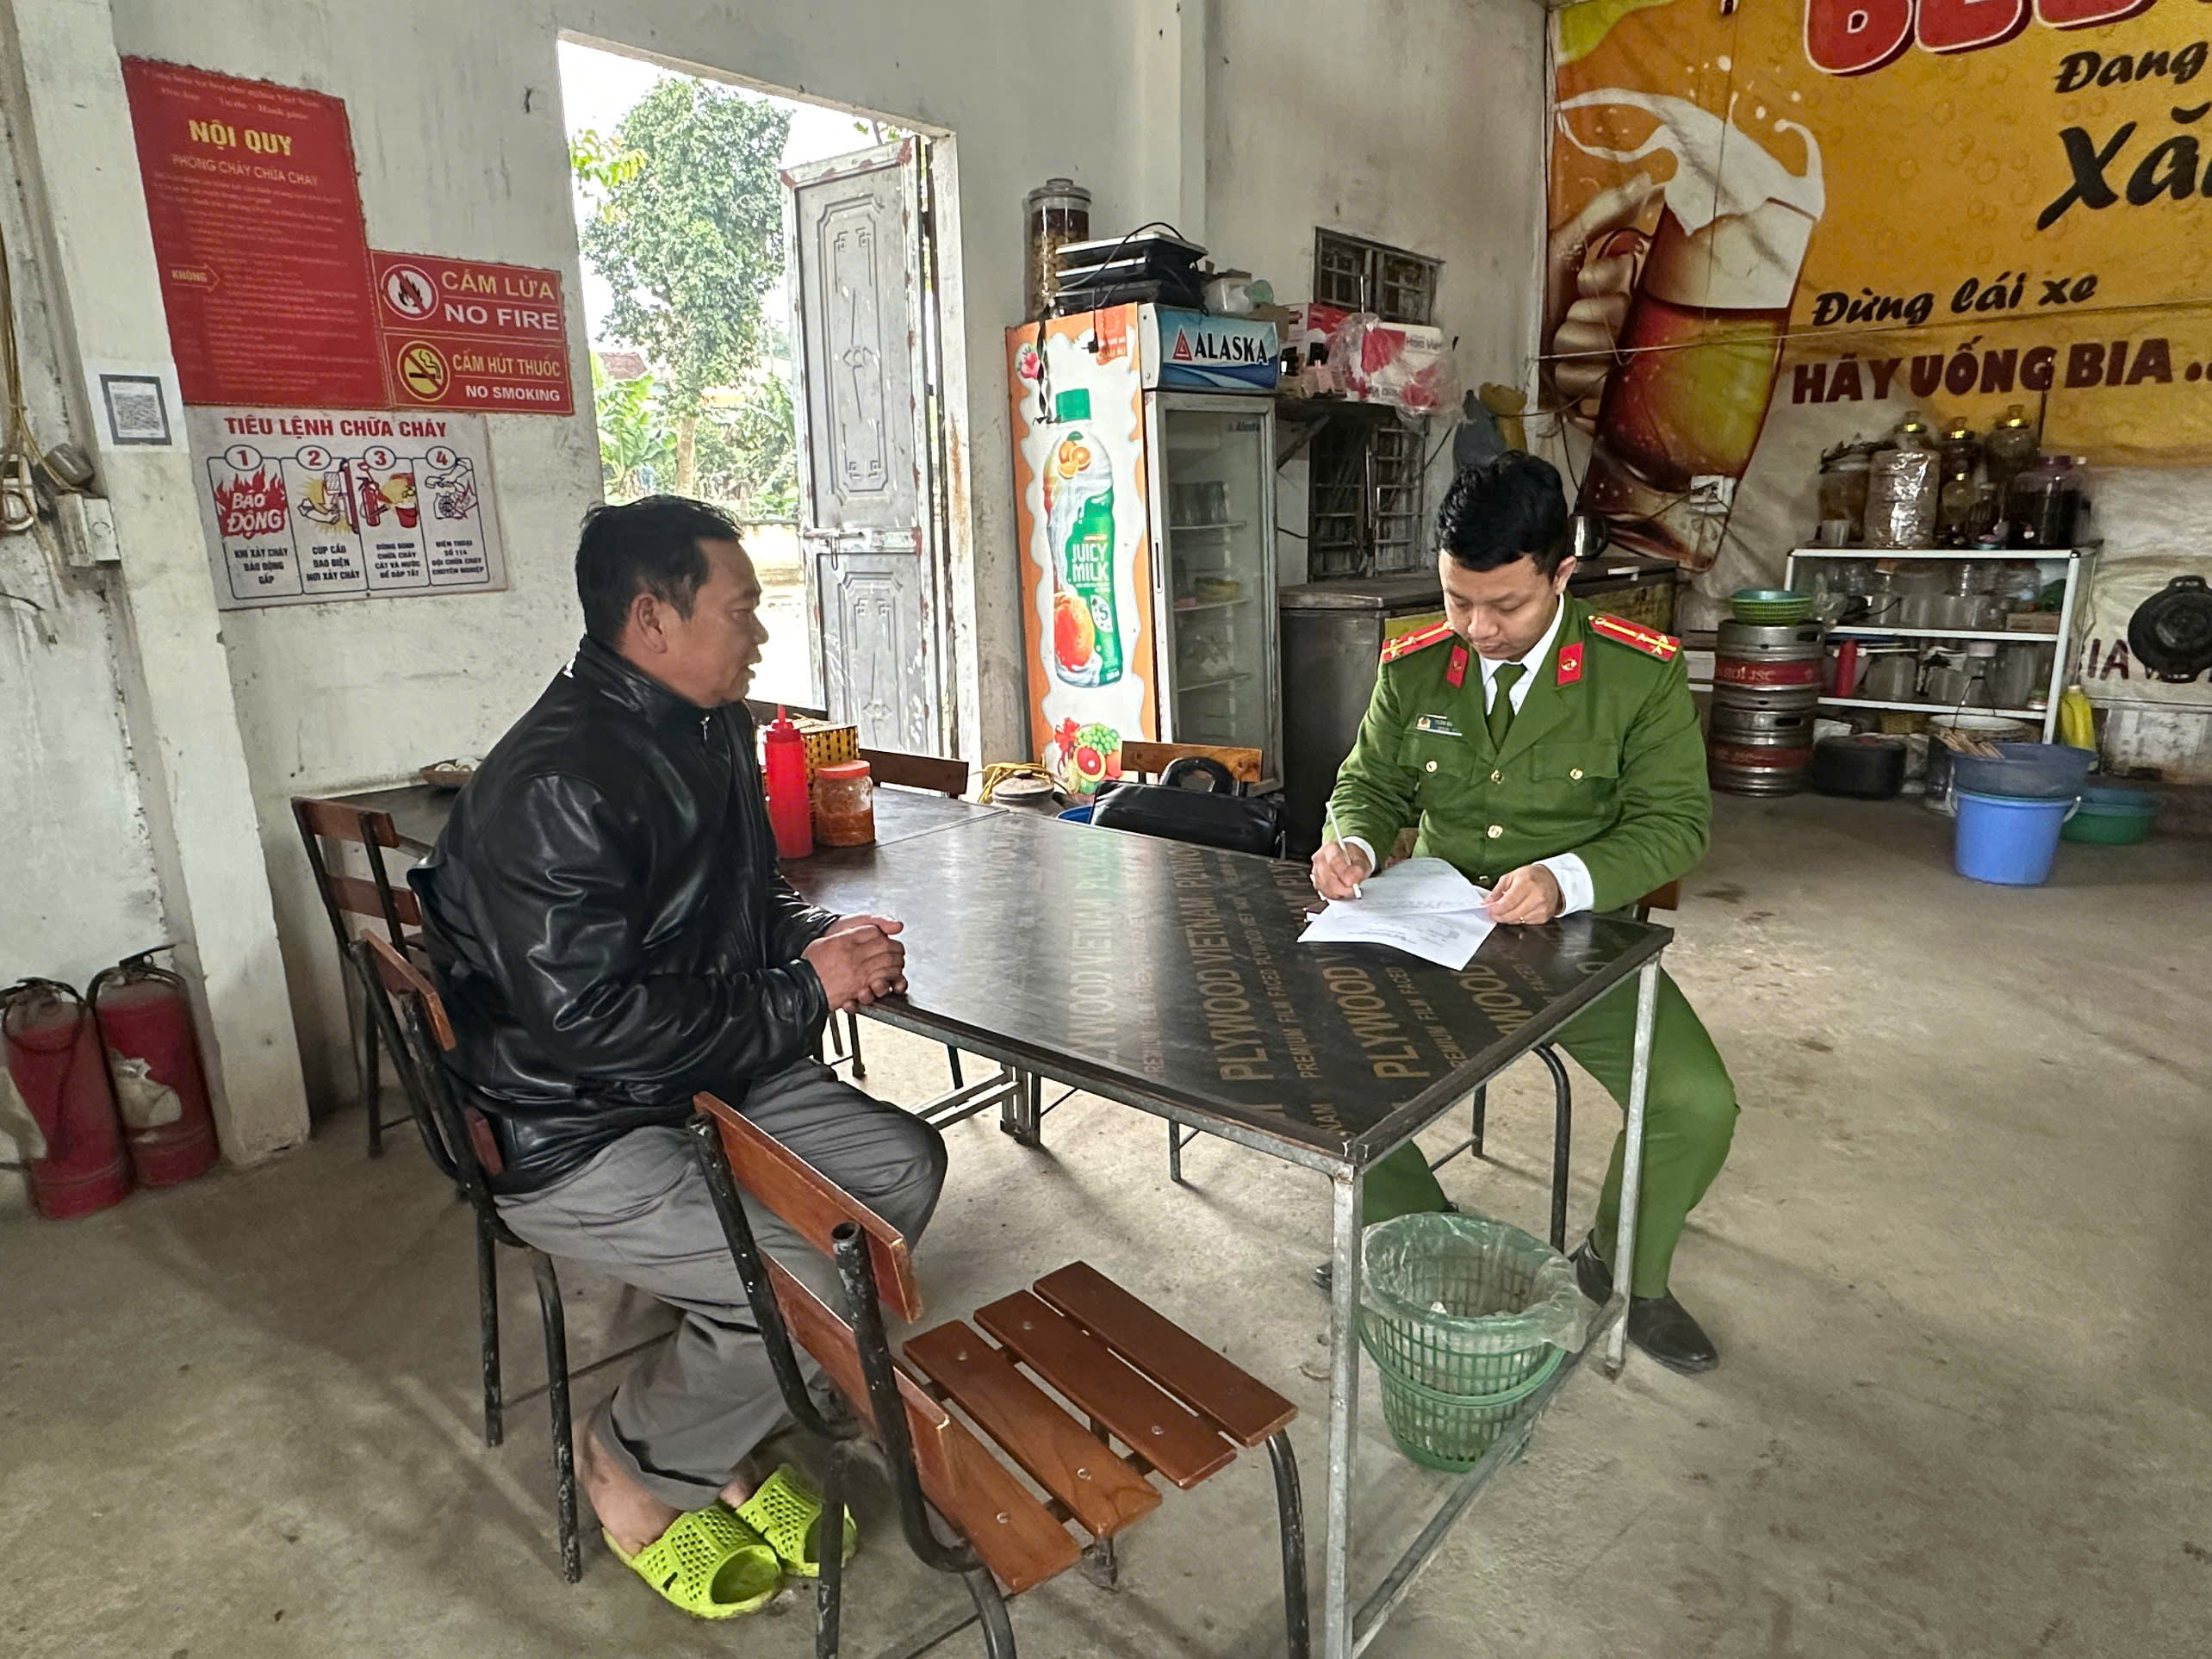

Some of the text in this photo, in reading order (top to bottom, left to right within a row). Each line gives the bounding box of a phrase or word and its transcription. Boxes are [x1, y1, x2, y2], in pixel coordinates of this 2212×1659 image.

[2054, 40, 2209, 93] Đang
[189, 119, 292, 156] NỘI QUY
[2036, 102, 2212, 231] Xă
[441, 269, 555, 300] CẤM LỬA
[1812, 271, 2098, 327] Đừng lái xe
[444, 303, 560, 330] NO FIRE
[1194, 331, 1269, 363] ALASKA
[452, 348, 560, 376] CẤM HÚT THUỐC
[1911, 335, 2058, 398] UỐNG
[466, 386, 561, 401] NO SMOKING
[224, 414, 446, 438] TIÊU LỆNH CHỮA CHÁY
[236, 450, 249, 466] 1
[307, 450, 322, 466] 2
[374, 450, 387, 465] 3
[436, 451, 448, 465] 4
[232, 490, 266, 509] BÁO
[227, 509, 282, 534] ĐỘNG
[1072, 543, 1108, 562] JUICY
[1072, 562, 1110, 582] MILK
[1177, 897, 1234, 964] VIETNAM
[1260, 969, 1286, 997] FACED
[1271, 1001, 1299, 1023] FILM
[1450, 965, 1534, 1034] WOOD
[1196, 968, 1274, 1080] PLYWOOD
[1322, 966, 1431, 1078] PLYWOOD
[1385, 966, 1468, 1068] REMIUM FILM FACED
[1283, 1028, 1322, 1078] PREMIUM
